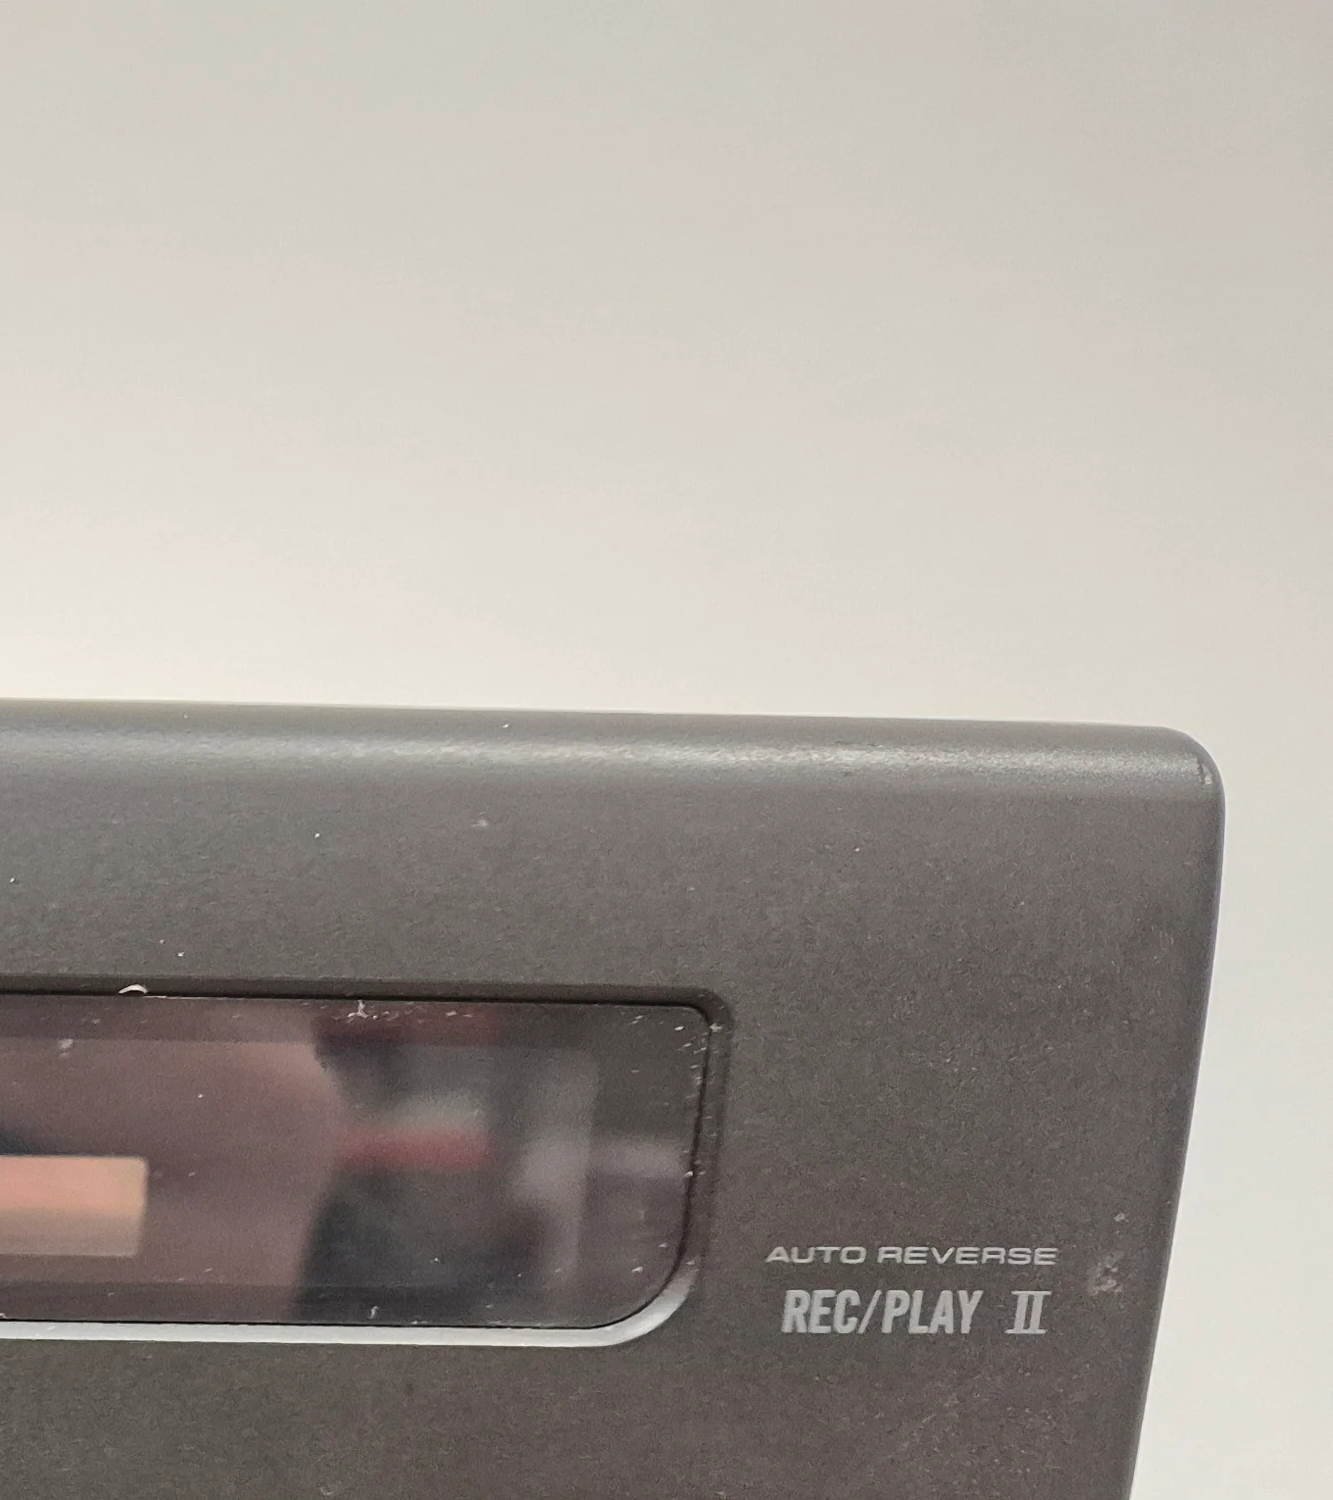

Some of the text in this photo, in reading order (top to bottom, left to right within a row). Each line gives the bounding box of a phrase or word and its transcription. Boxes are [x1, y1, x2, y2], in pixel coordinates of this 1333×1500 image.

[765, 1246, 1059, 1266] AUTO REVERSE
[781, 1289, 984, 1336] REC/PLAY
